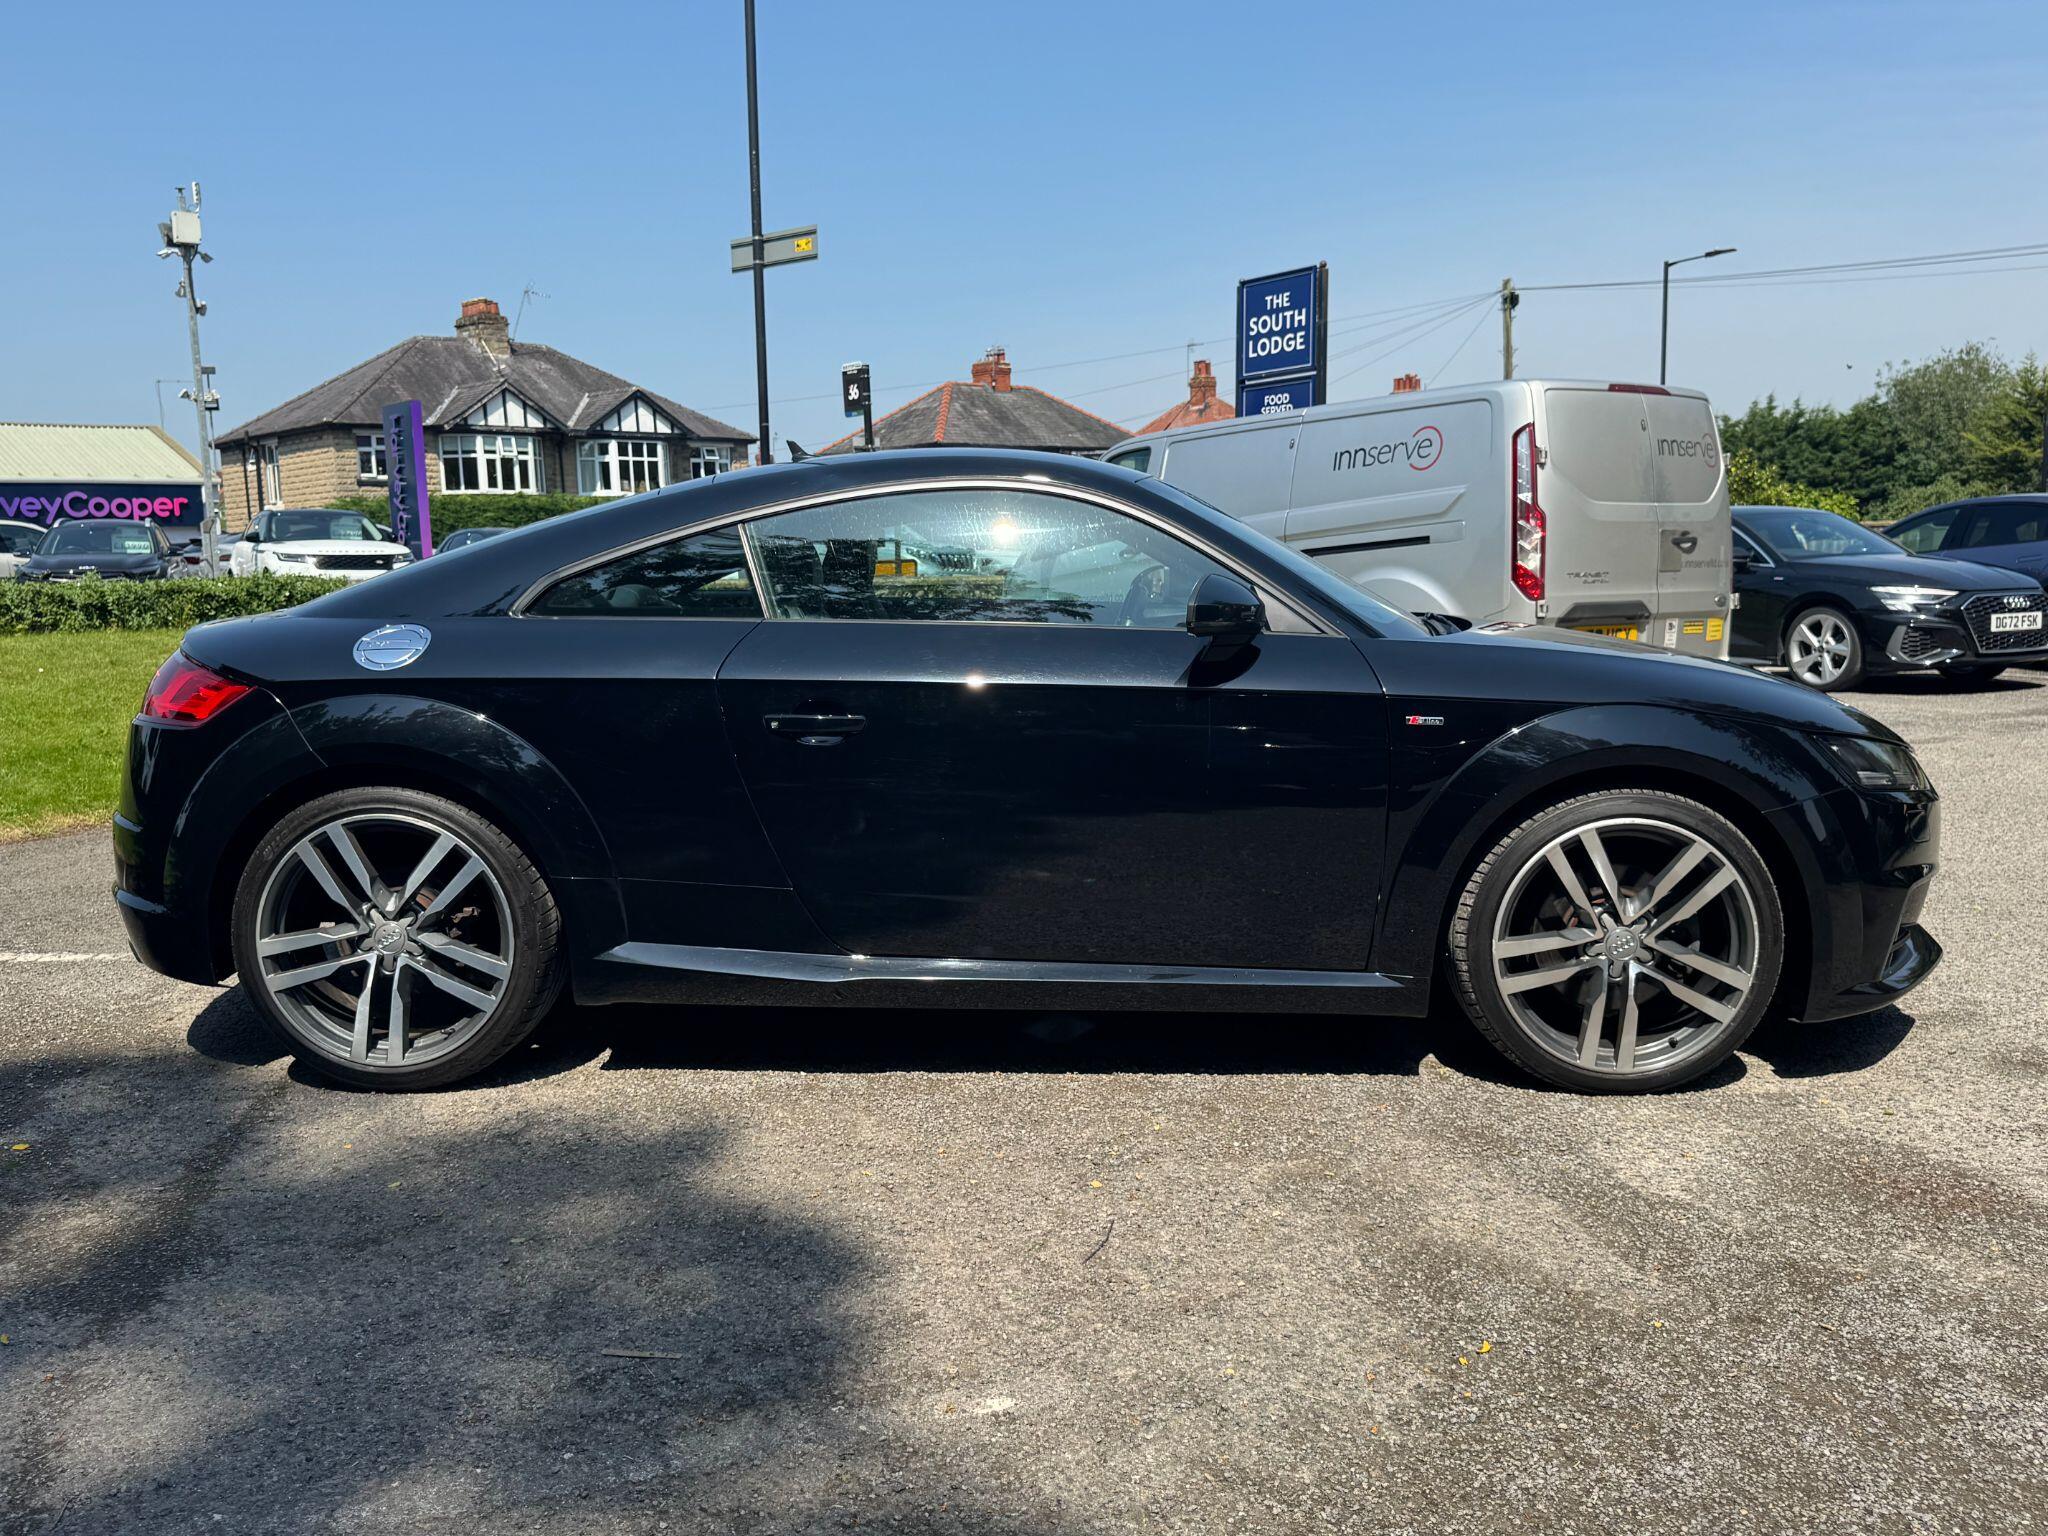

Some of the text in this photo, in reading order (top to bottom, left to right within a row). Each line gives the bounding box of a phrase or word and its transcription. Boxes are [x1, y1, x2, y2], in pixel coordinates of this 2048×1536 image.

[1265, 292, 1291, 310] THE
[1249, 307, 1306, 336] SOUTH
[1248, 331, 1305, 358] LODGE
[847, 383, 860, 401] 36
[1264, 393, 1290, 407] FOOD
[1333, 437, 1433, 471] innserve
[1657, 438, 1714, 459] innserve
[1995, 614, 2038, 629] DG72 FSK
